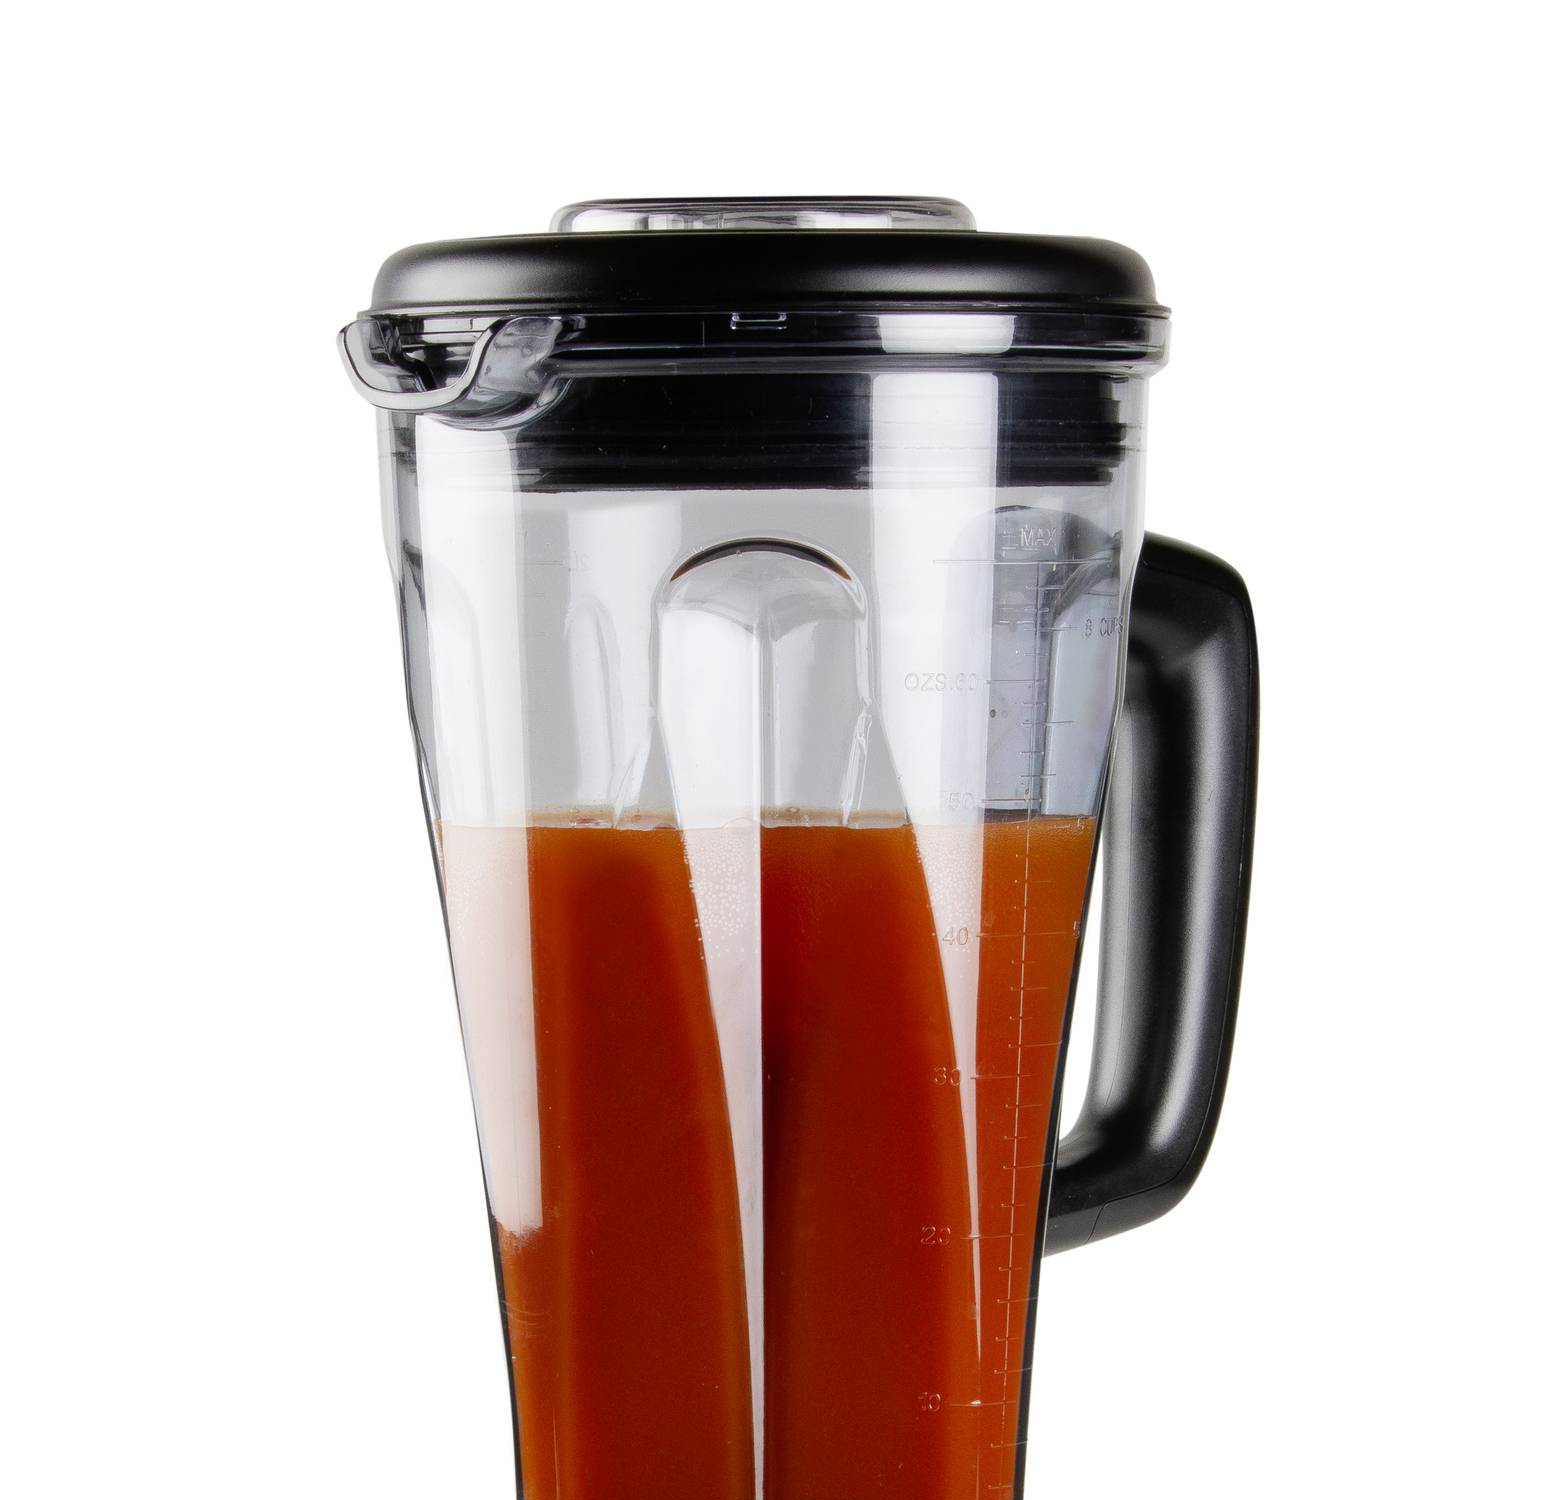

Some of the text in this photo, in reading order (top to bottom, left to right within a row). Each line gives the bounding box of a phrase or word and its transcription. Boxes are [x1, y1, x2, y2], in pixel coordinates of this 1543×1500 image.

[1020, 526, 1058, 547] MAX
[942, 926, 969, 946] 40
[933, 1066, 961, 1087] 30
[920, 1225, 951, 1246] 20
[917, 1391, 941, 1412] 10
